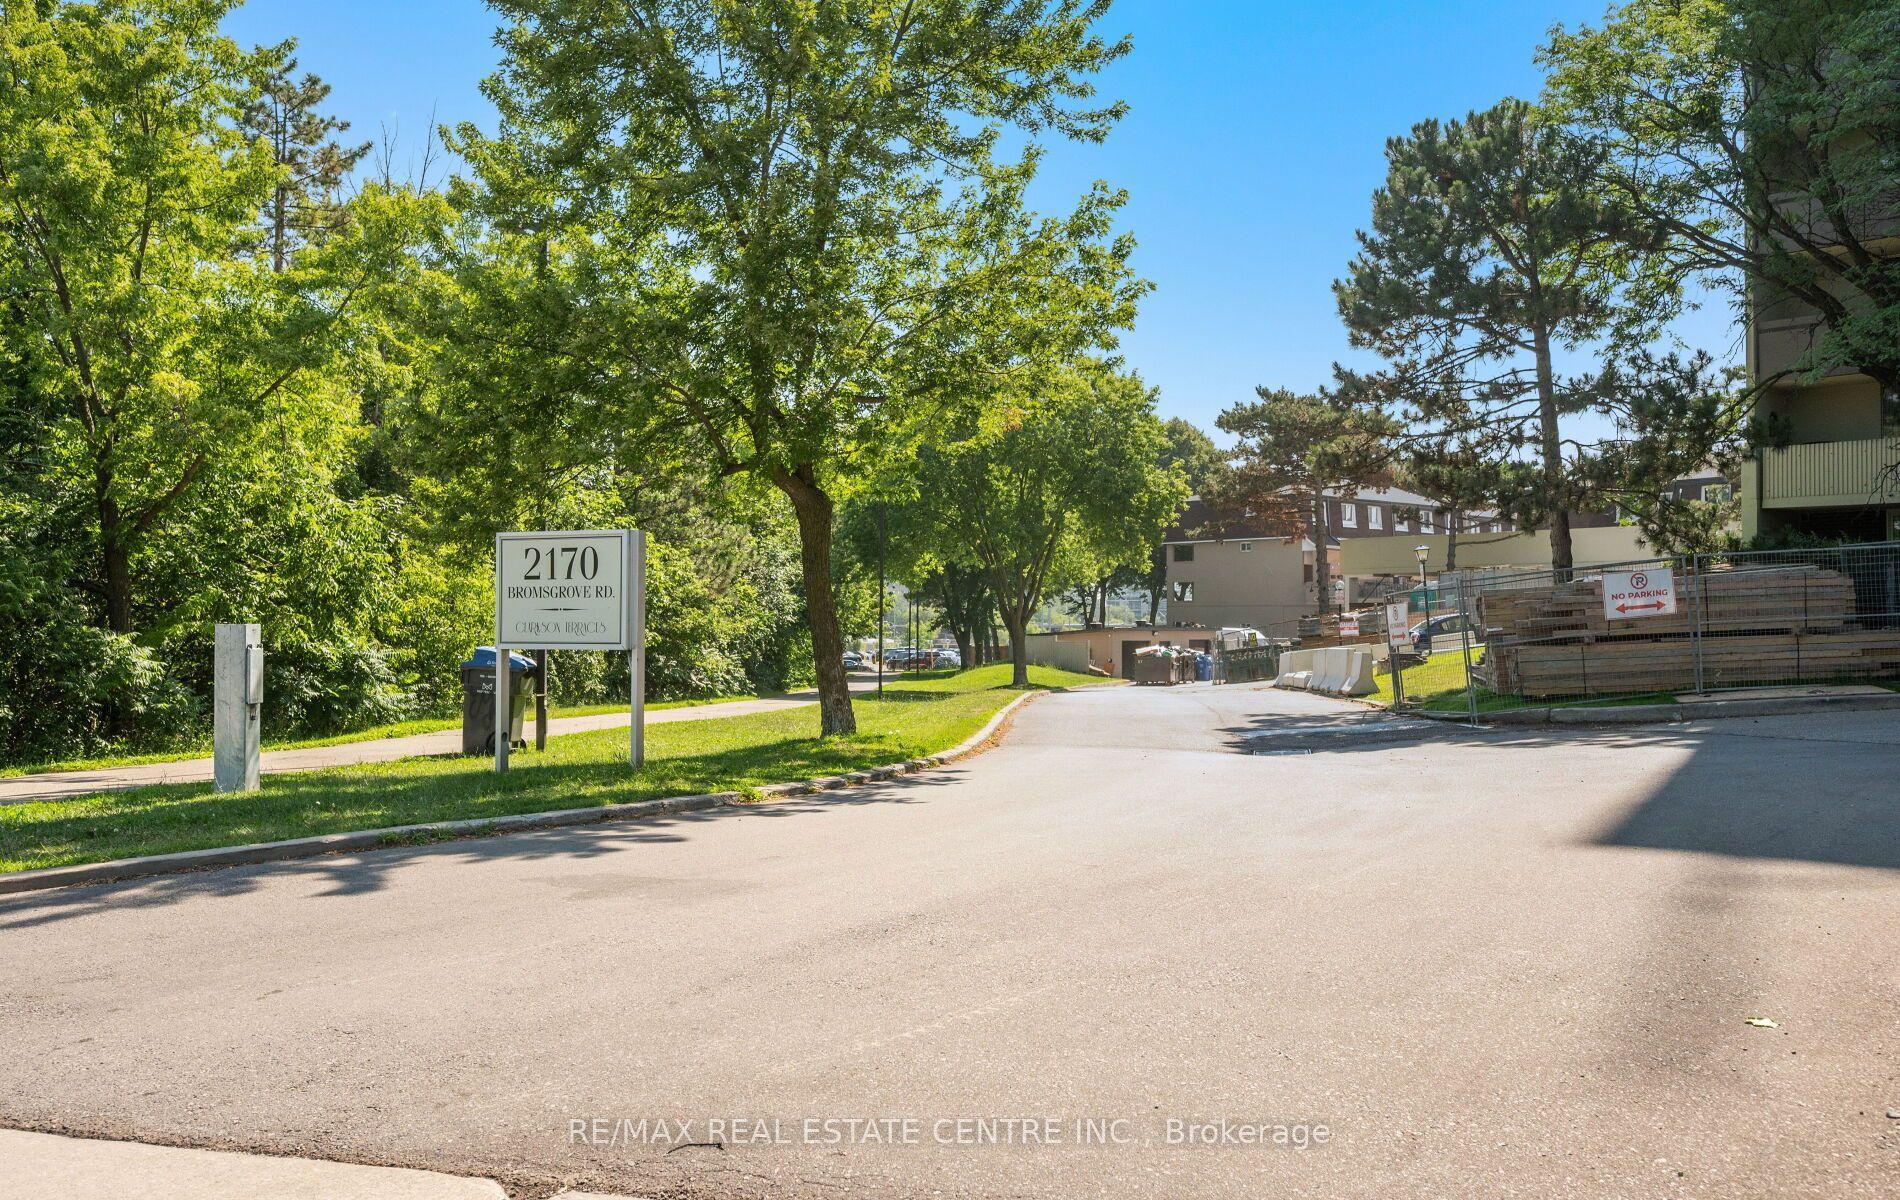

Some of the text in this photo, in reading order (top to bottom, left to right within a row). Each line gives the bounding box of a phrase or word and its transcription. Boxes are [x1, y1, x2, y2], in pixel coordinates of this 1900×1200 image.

[524, 546, 599, 580] 2170
[508, 585, 615, 599] BROMSGROVE RD.
[1628, 589, 1668, 599] PARKING
